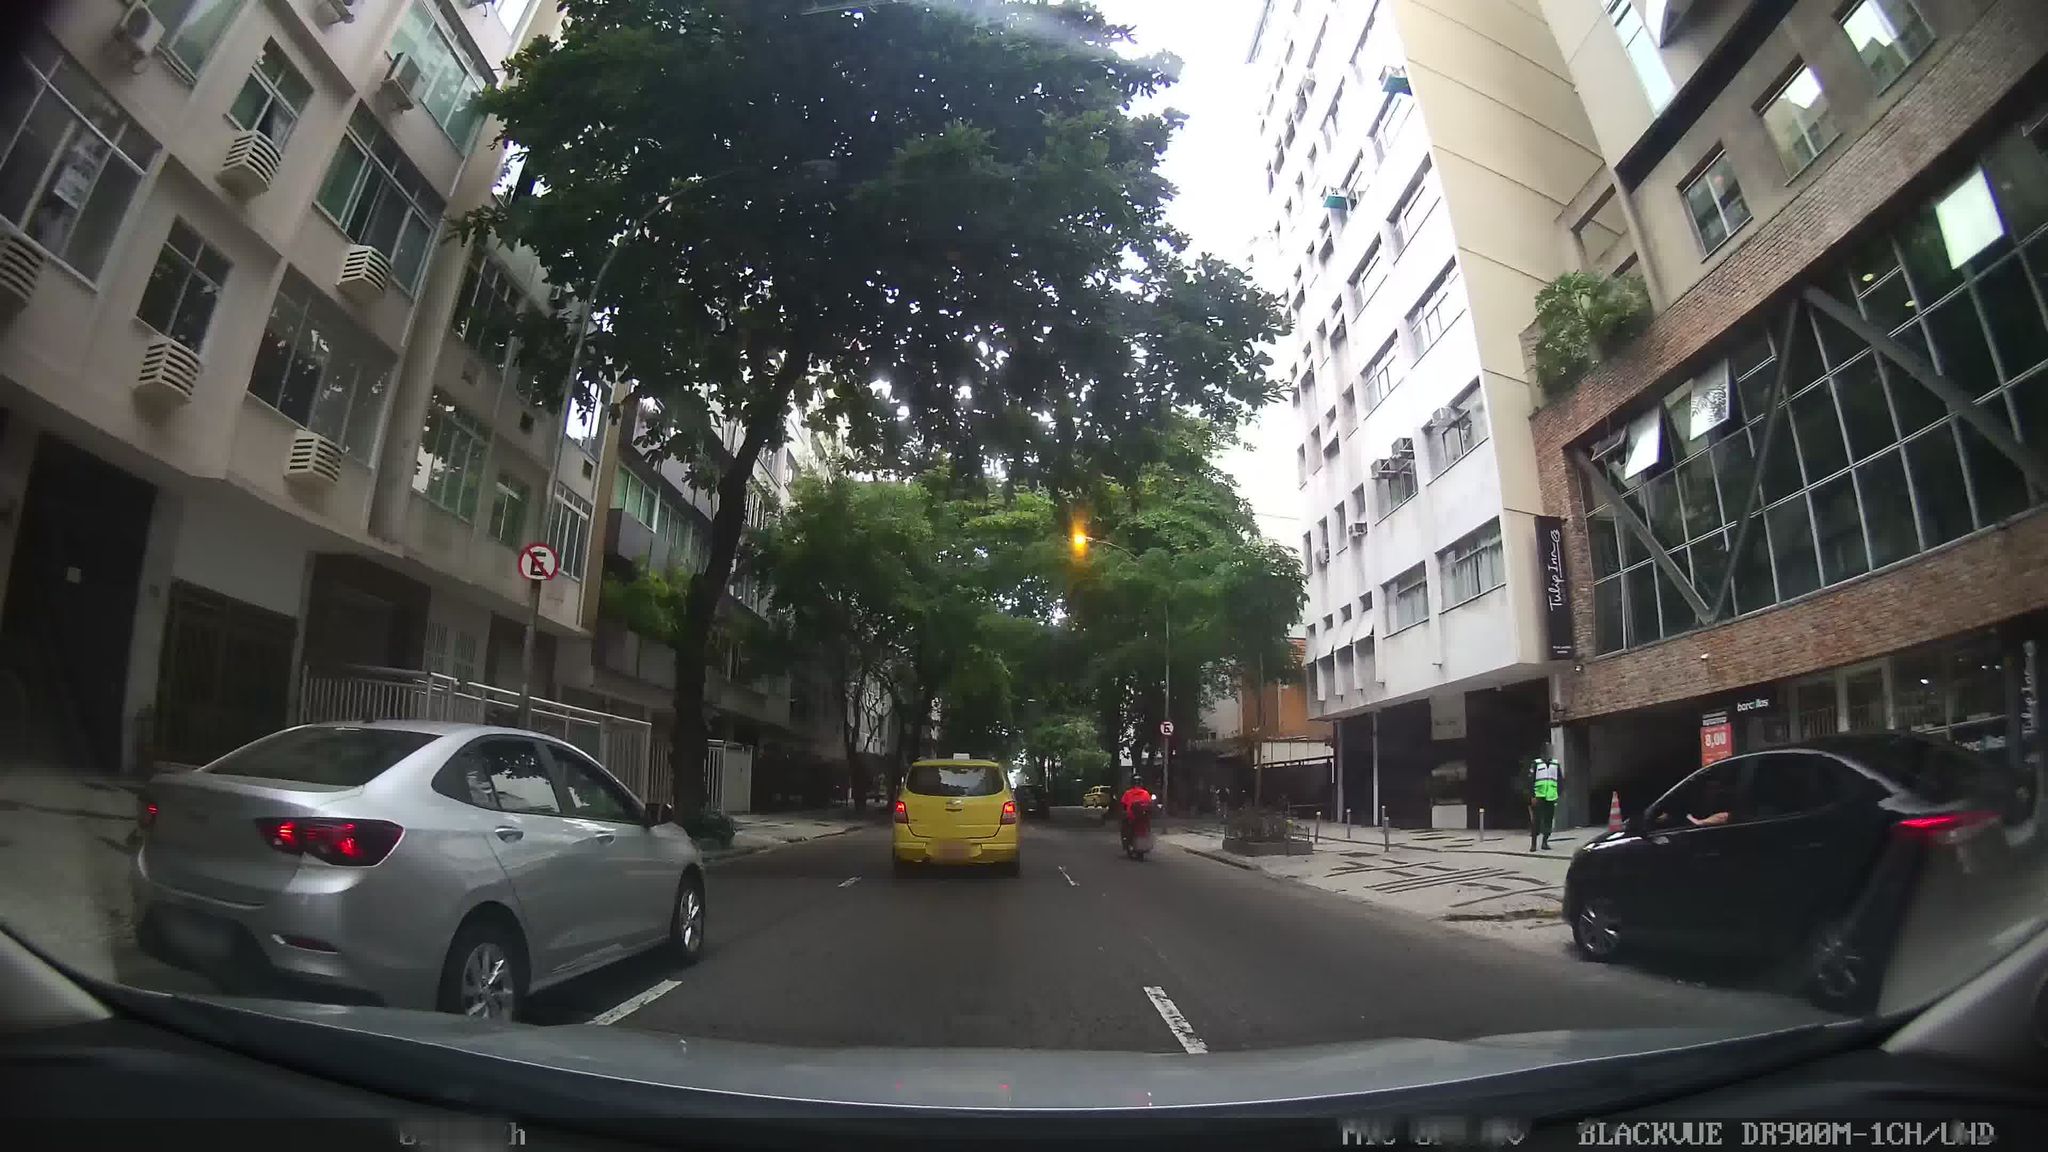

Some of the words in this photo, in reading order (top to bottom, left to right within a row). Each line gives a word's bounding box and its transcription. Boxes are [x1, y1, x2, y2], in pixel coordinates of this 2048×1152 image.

[530, 551, 547, 575] E
[1548, 542, 1559, 571] Inn
[1548, 575, 1564, 611] Tulip
[1705, 732, 1726, 748] 8,00
